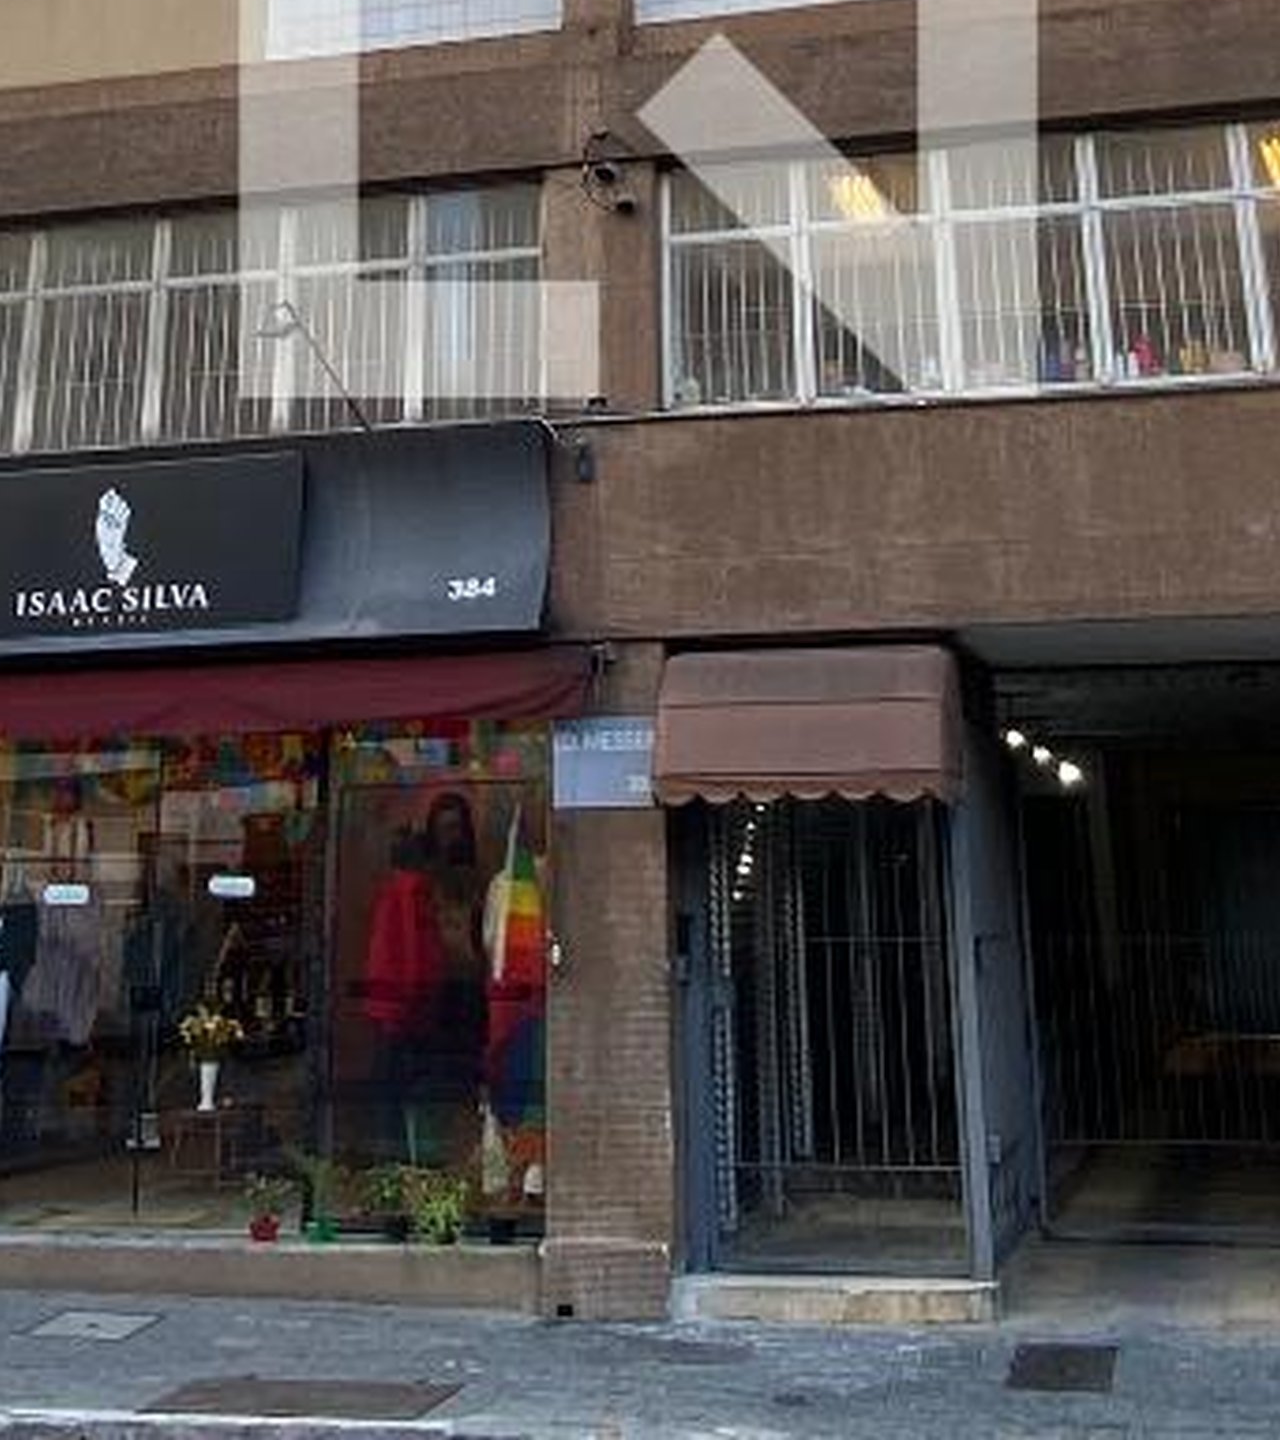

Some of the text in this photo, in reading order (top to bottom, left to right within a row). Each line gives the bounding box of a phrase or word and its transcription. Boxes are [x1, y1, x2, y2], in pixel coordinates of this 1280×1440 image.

[16, 584, 209, 617] ISAAC SILVA
[447, 577, 496, 601] 384
